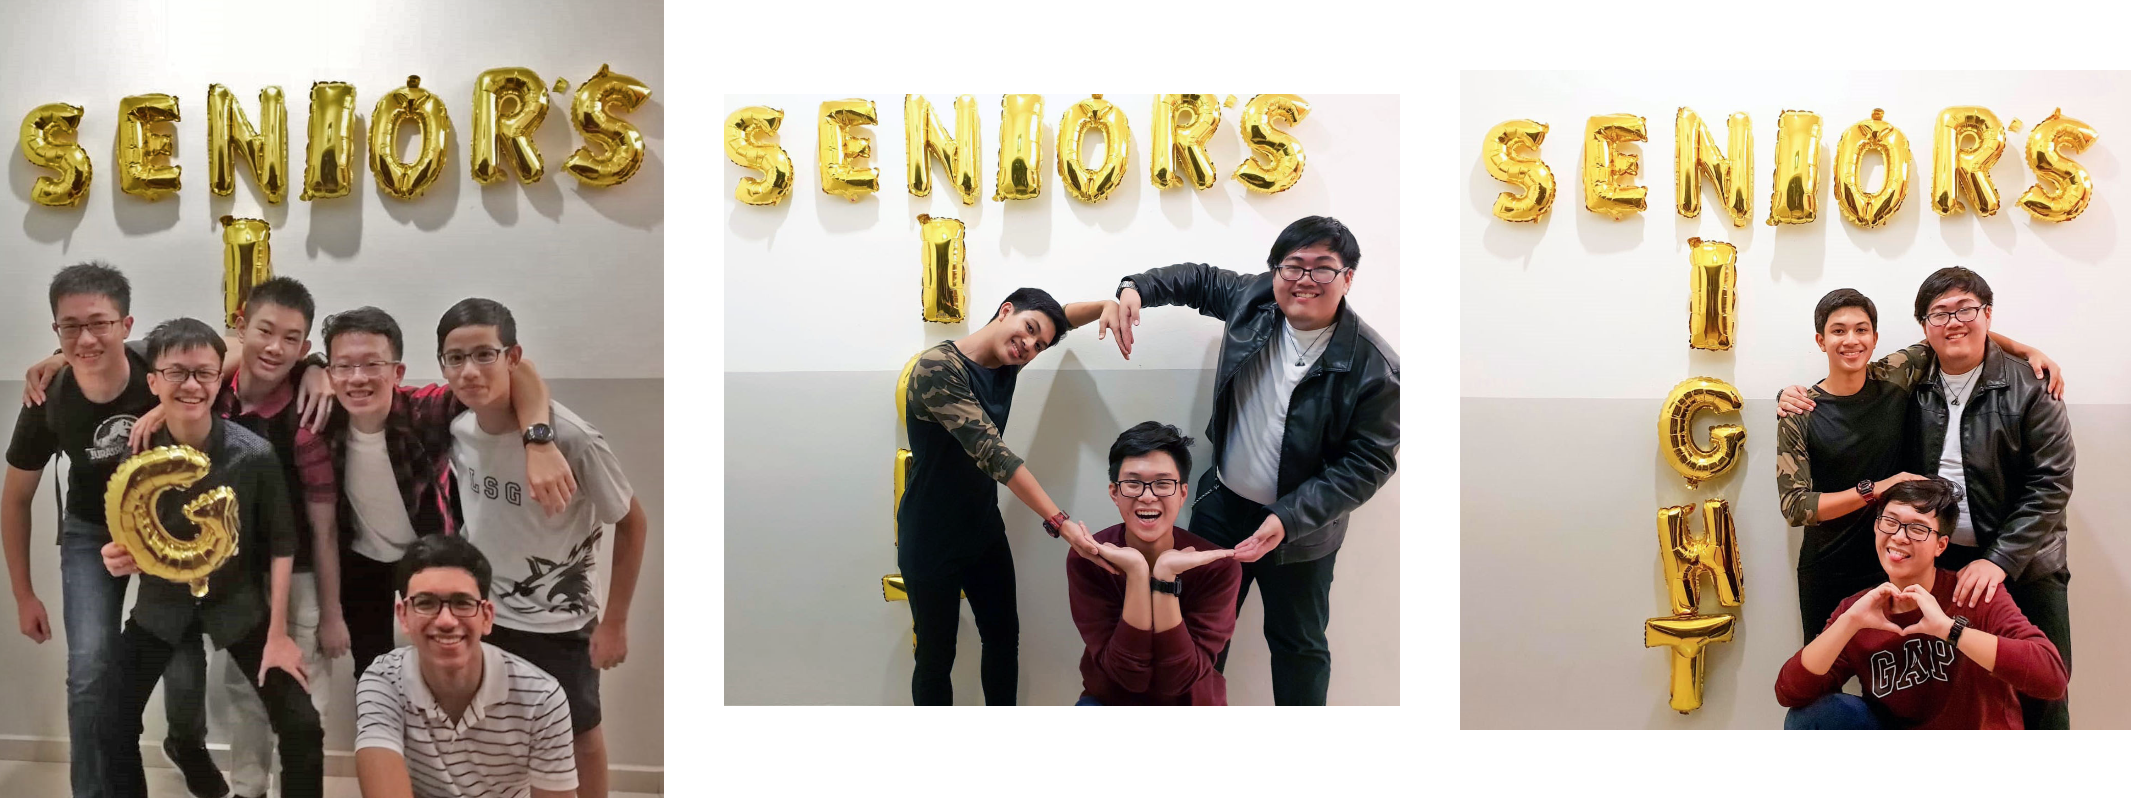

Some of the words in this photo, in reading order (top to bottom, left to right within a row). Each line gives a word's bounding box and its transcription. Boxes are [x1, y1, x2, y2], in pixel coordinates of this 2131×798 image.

[20, 63, 653, 206] SENIOR'S
[1482, 106, 2099, 228] SENIOR'S
[104, 444, 241, 597] G
[468, 467, 522, 507] LSG
[1870, 638, 1955, 698] GAP
